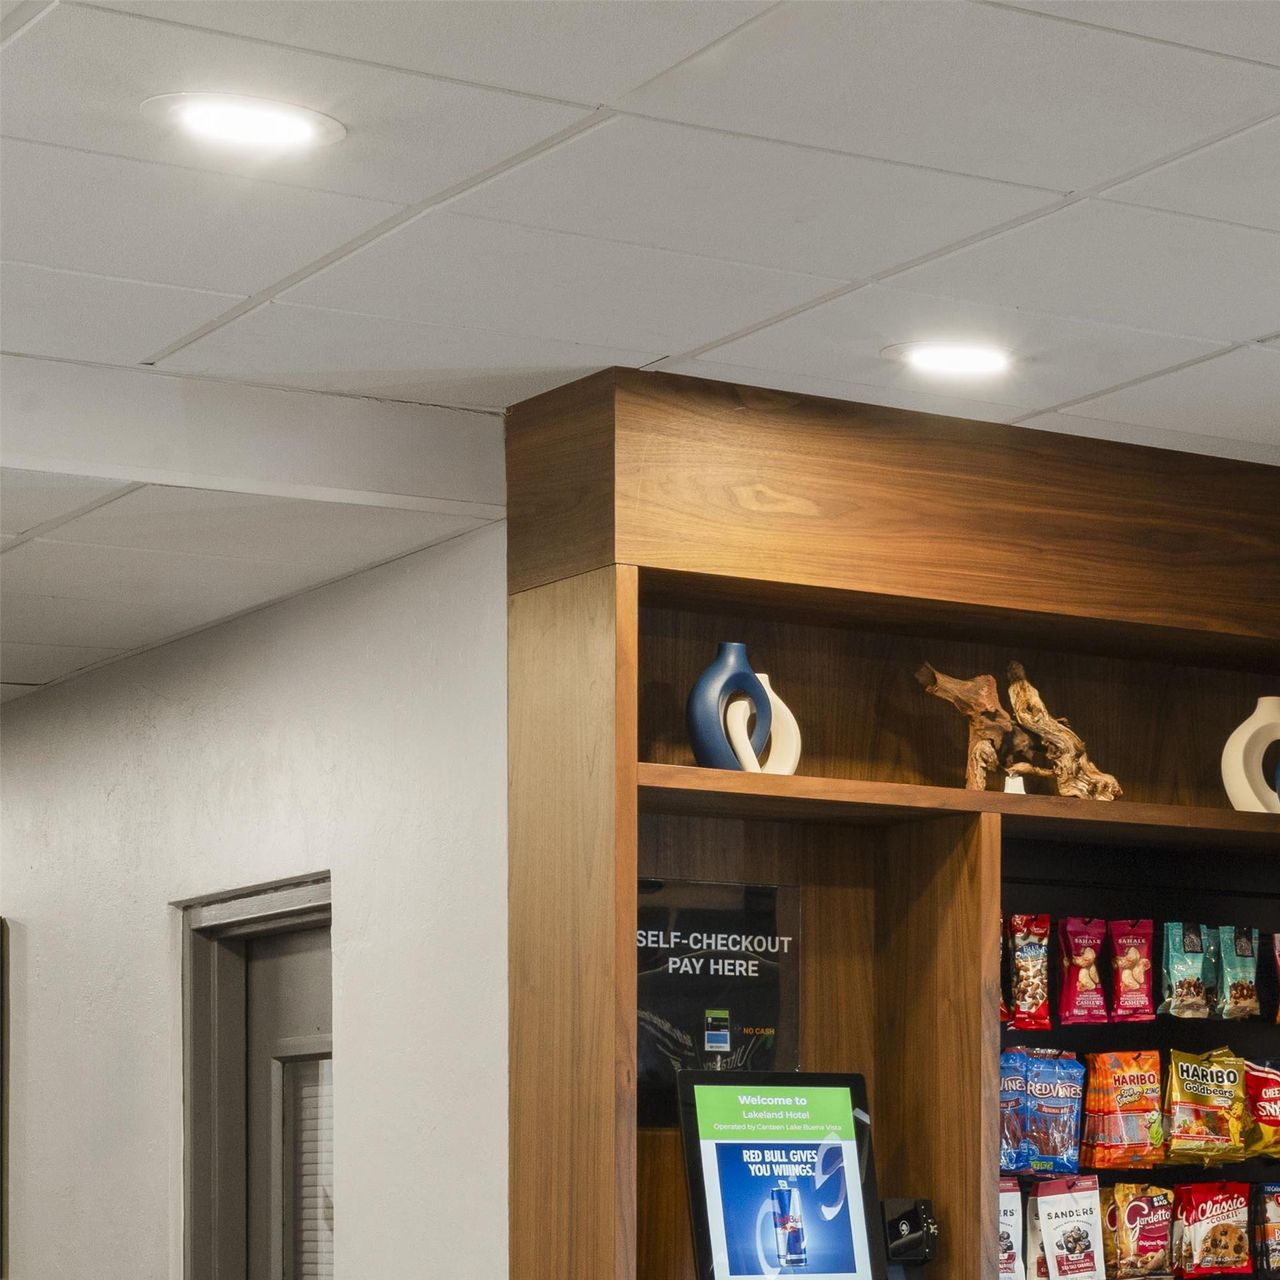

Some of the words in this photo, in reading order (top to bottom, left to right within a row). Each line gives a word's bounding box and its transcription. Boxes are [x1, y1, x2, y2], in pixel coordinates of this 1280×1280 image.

[636, 930, 792, 953] SELF-CHECKOUT
[668, 957, 704, 975] PAY
[710, 959, 759, 977] HERE
[743, 1027, 754, 1035] NO
[755, 1027, 775, 1036] CASH
[1179, 1062, 1238, 1085] HARIBO
[1113, 1074, 1156, 1087] HARIBO
[1184, 1082, 1234, 1098] Goldbears
[738, 1095, 793, 1106] Welcome
[795, 1096, 808, 1106] to
[743, 1110, 783, 1119] Lakeland
[786, 1111, 809, 1119] Hotel
[714, 1123, 747, 1132] Operated
[748, 1123, 756, 1132] by
[757, 1123, 785, 1131] Canteen
[786, 1123, 802, 1131] Lake
[743, 1150, 762, 1162] RED
[764, 1150, 788, 1162] BULL
[790, 1150, 817, 1162] GIVES
[748, 1164, 771, 1177] YOU
[1153, 1199, 1168, 1207] BAG
[1197, 1194, 1246, 1221] Classic
[1047, 1207, 1094, 1220] SANDERS
